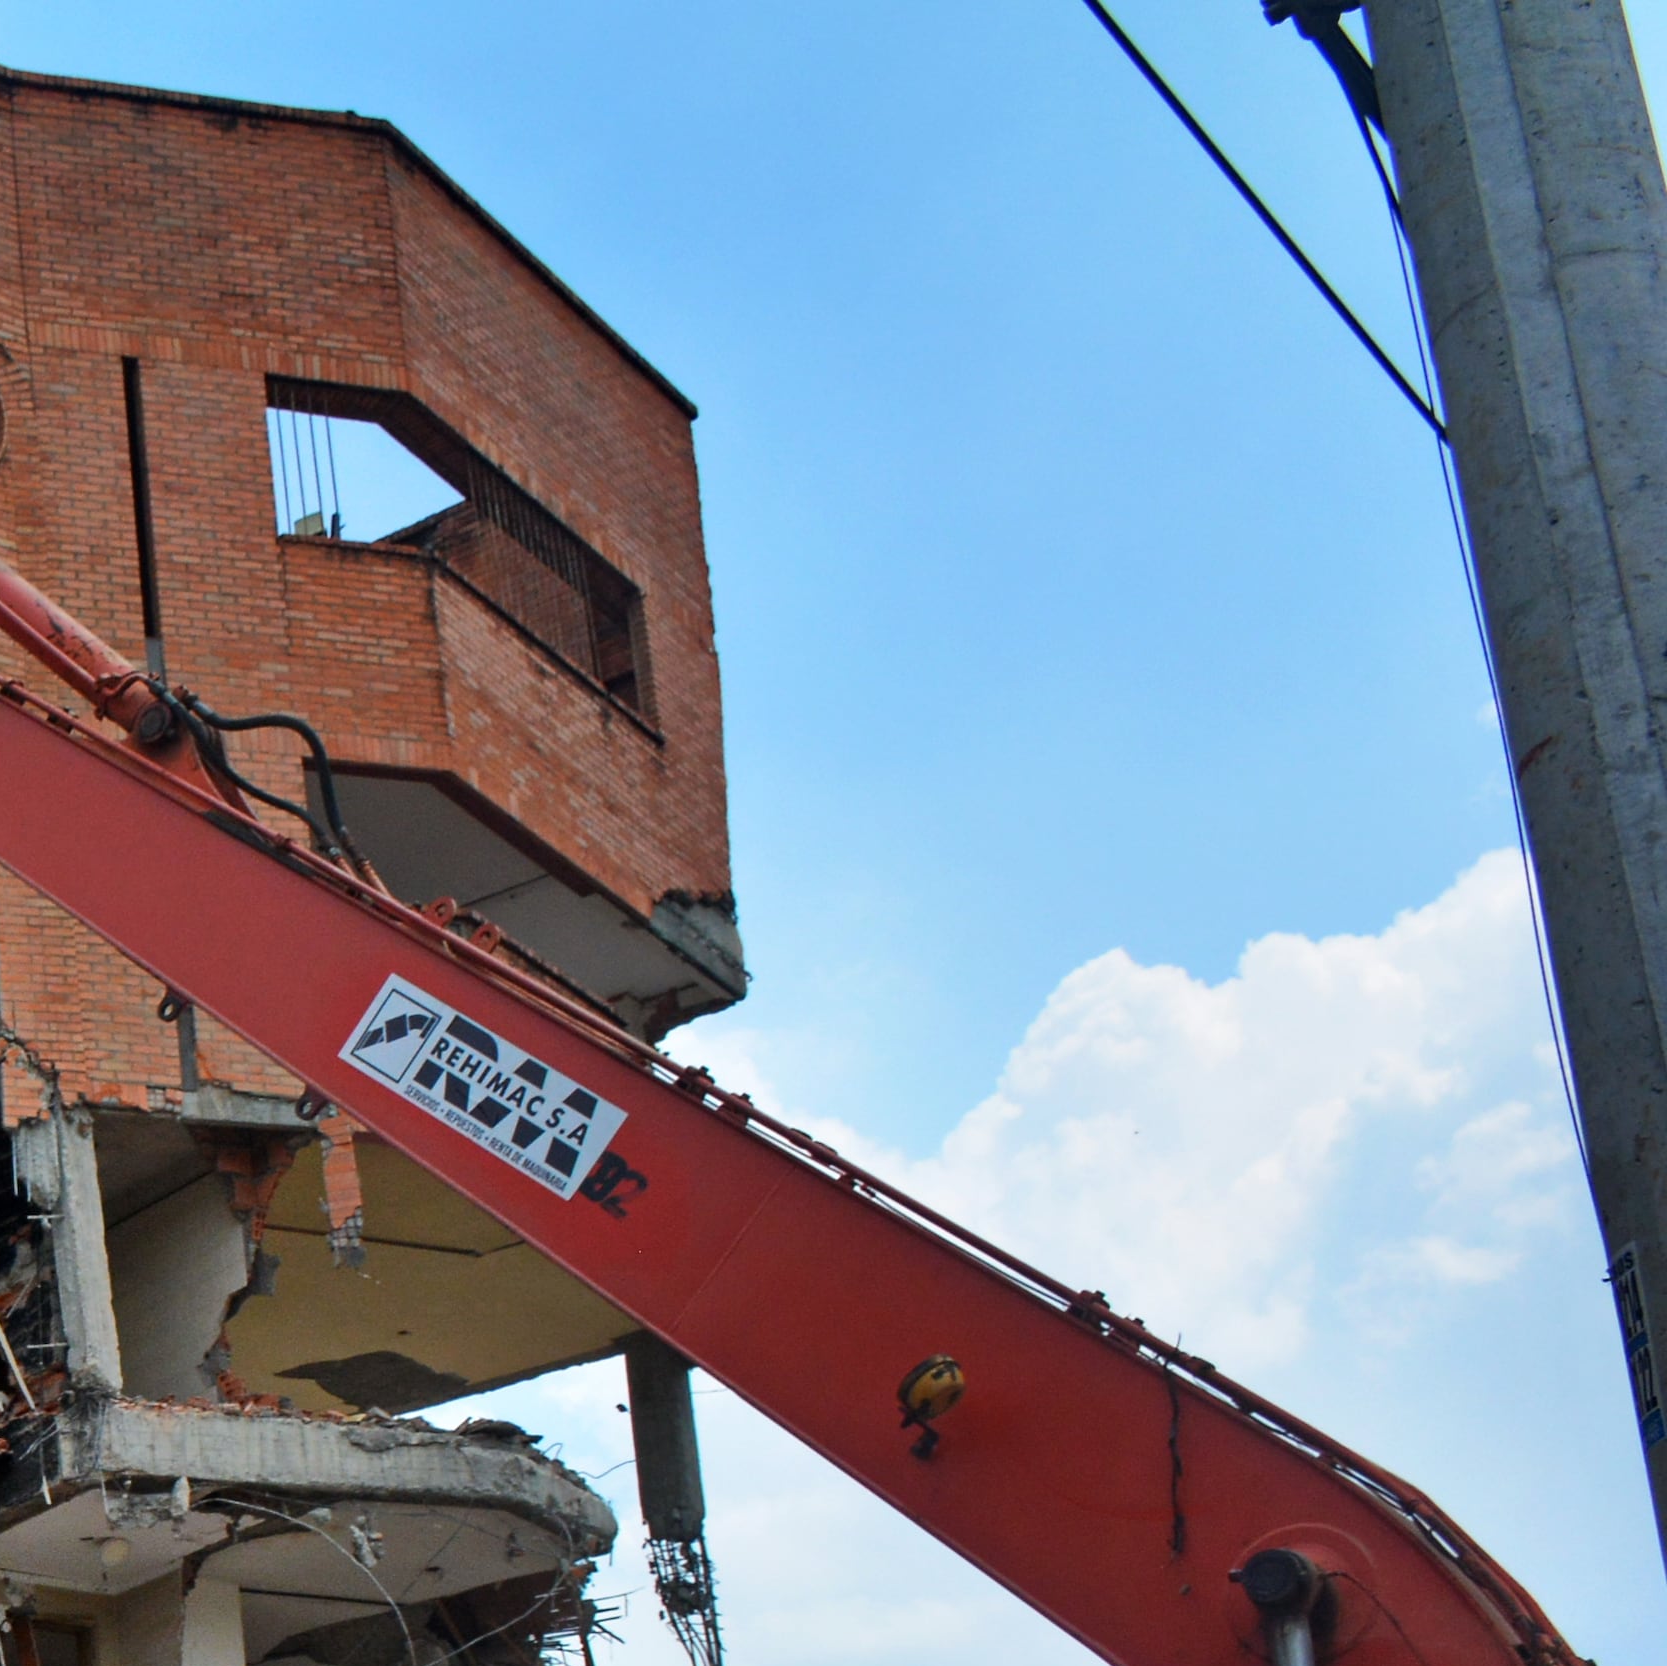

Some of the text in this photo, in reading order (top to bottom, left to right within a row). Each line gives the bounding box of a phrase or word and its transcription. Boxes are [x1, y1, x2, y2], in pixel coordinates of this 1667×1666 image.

[404, 1084, 568, 1192] SERVICIOS REPUESTOS RENTA DE MAQUINARIA
[430, 1037, 589, 1146] REHIMAC S.A
